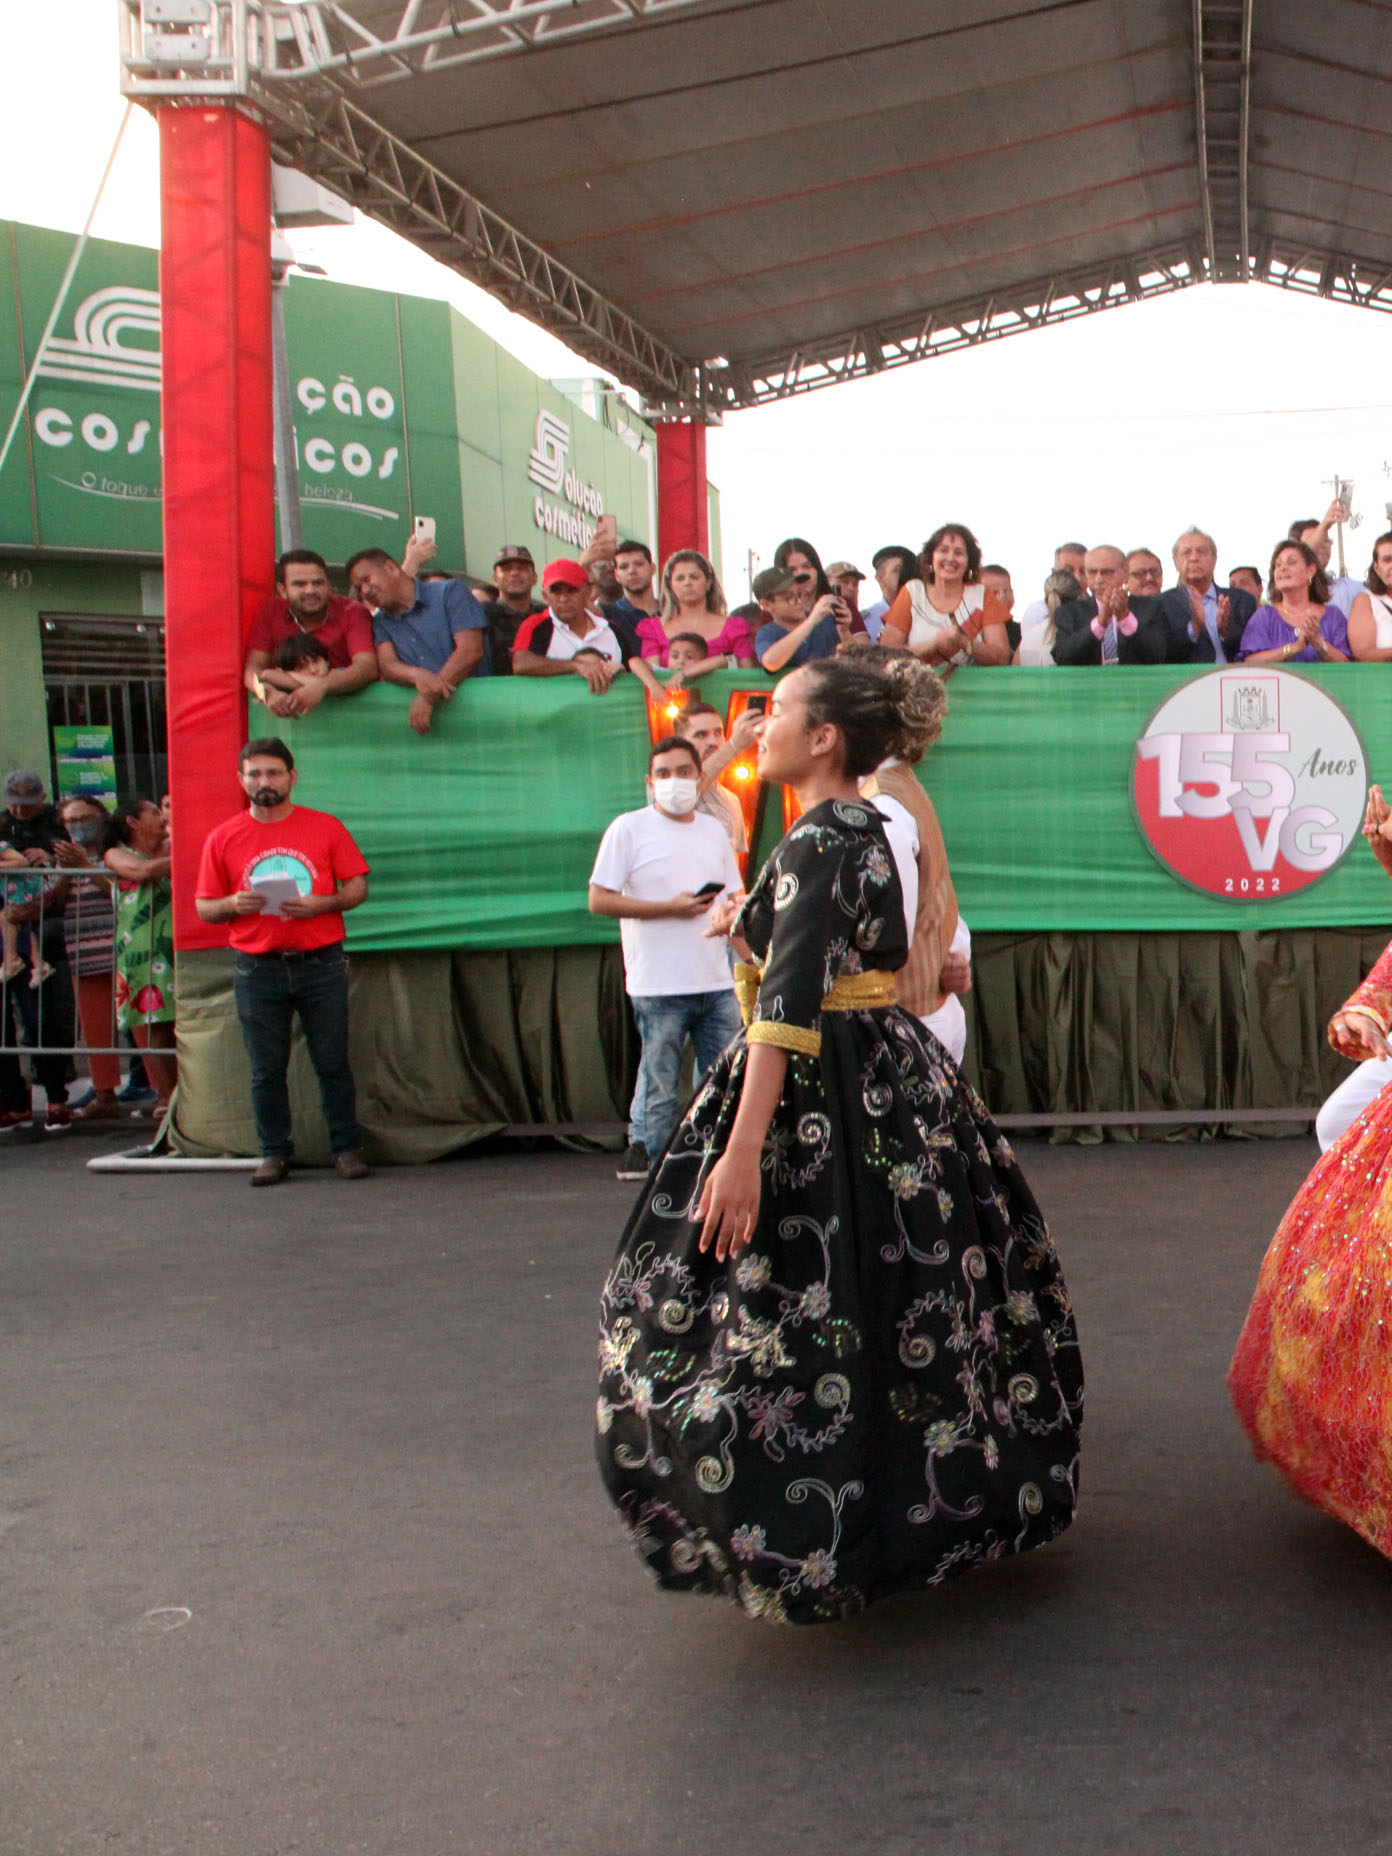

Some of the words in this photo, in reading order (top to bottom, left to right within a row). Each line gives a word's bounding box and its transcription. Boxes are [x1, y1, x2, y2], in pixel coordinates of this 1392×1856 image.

[1136, 732, 1295, 819] 155
[1297, 747, 1359, 779] Anos
[1231, 805, 1344, 872] VG
[1225, 877, 1281, 892] 2022
